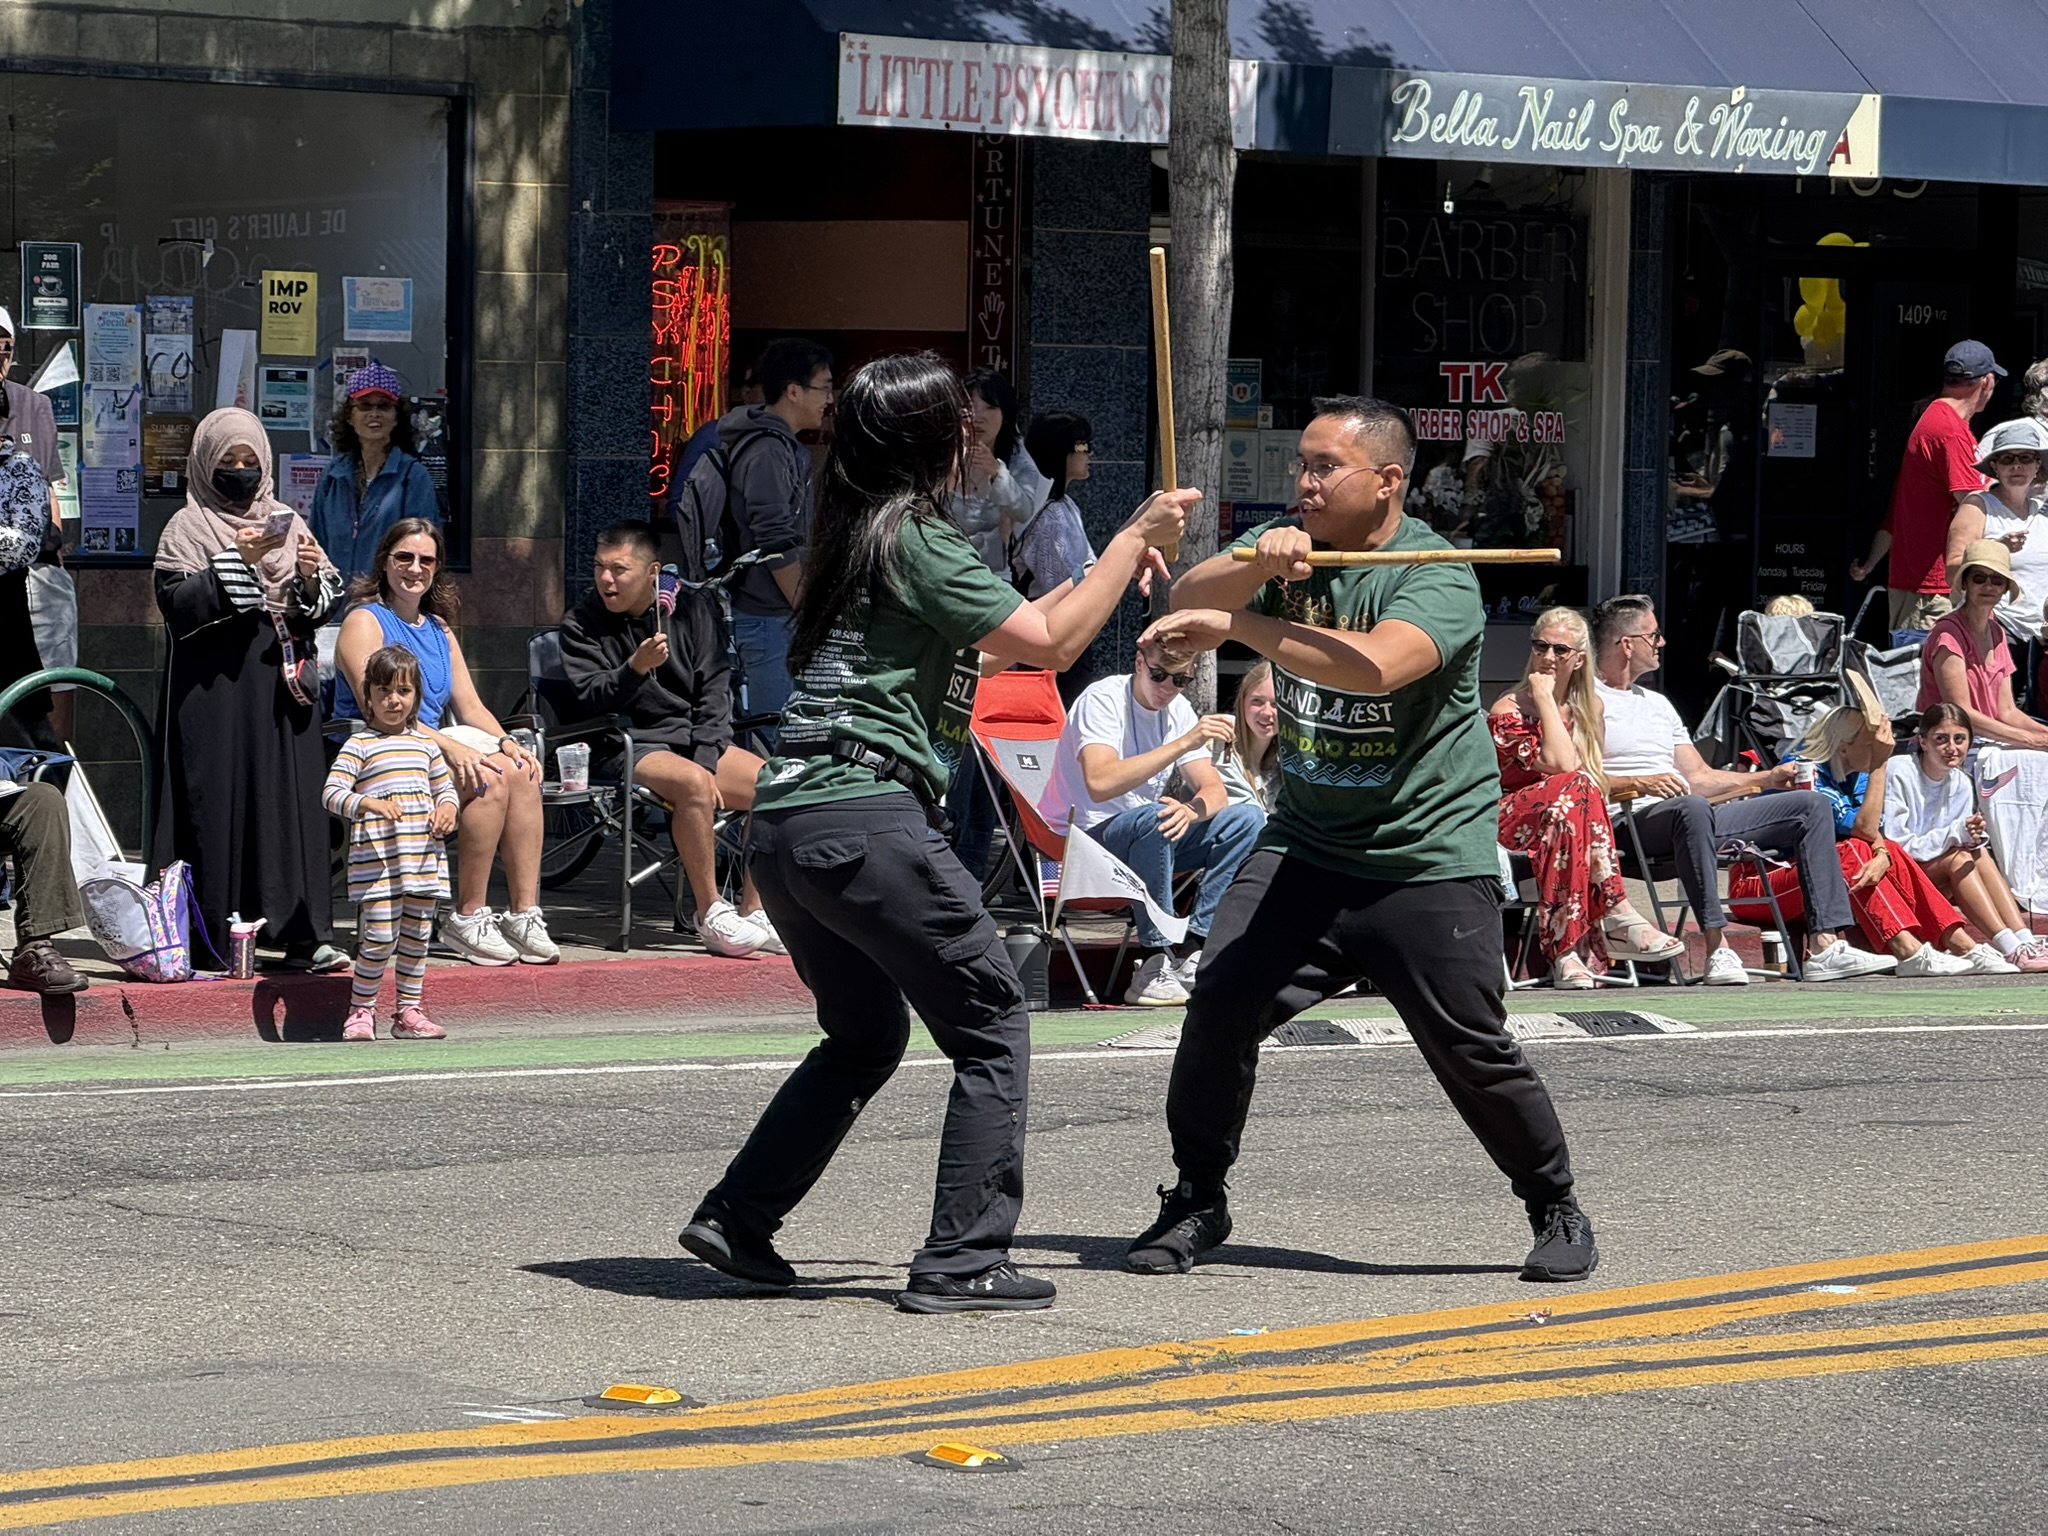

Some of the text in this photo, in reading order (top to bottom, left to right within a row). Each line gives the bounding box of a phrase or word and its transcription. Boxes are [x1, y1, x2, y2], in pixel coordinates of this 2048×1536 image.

[856, 53, 982, 123] LITTLE
[991, 62, 1139, 134] PSYCHIC
[1391, 78, 1828, 174] Bella Nail Spa & Waxing
[1382, 216, 1577, 283] BARBER
[269, 279, 308, 297] IMP
[268, 301, 302, 315] ROV
[1412, 292, 1547, 354] SHOP
[1898, 304, 1931, 324] 1409
[1439, 362, 1508, 403] TK
[150, 423, 191, 433] SUMMER
[1466, 409, 1512, 442] SHOP
[1516, 411, 1529, 443] &
[1533, 411, 1566, 444] SPA
[1775, 543, 1805, 555] HOURS
[1801, 581, 1827, 594] Friday
[947, 672, 976, 705] ISL
[1275, 677, 1393, 724] SLAND FEST
[1349, 742, 1398, 757] 2024
